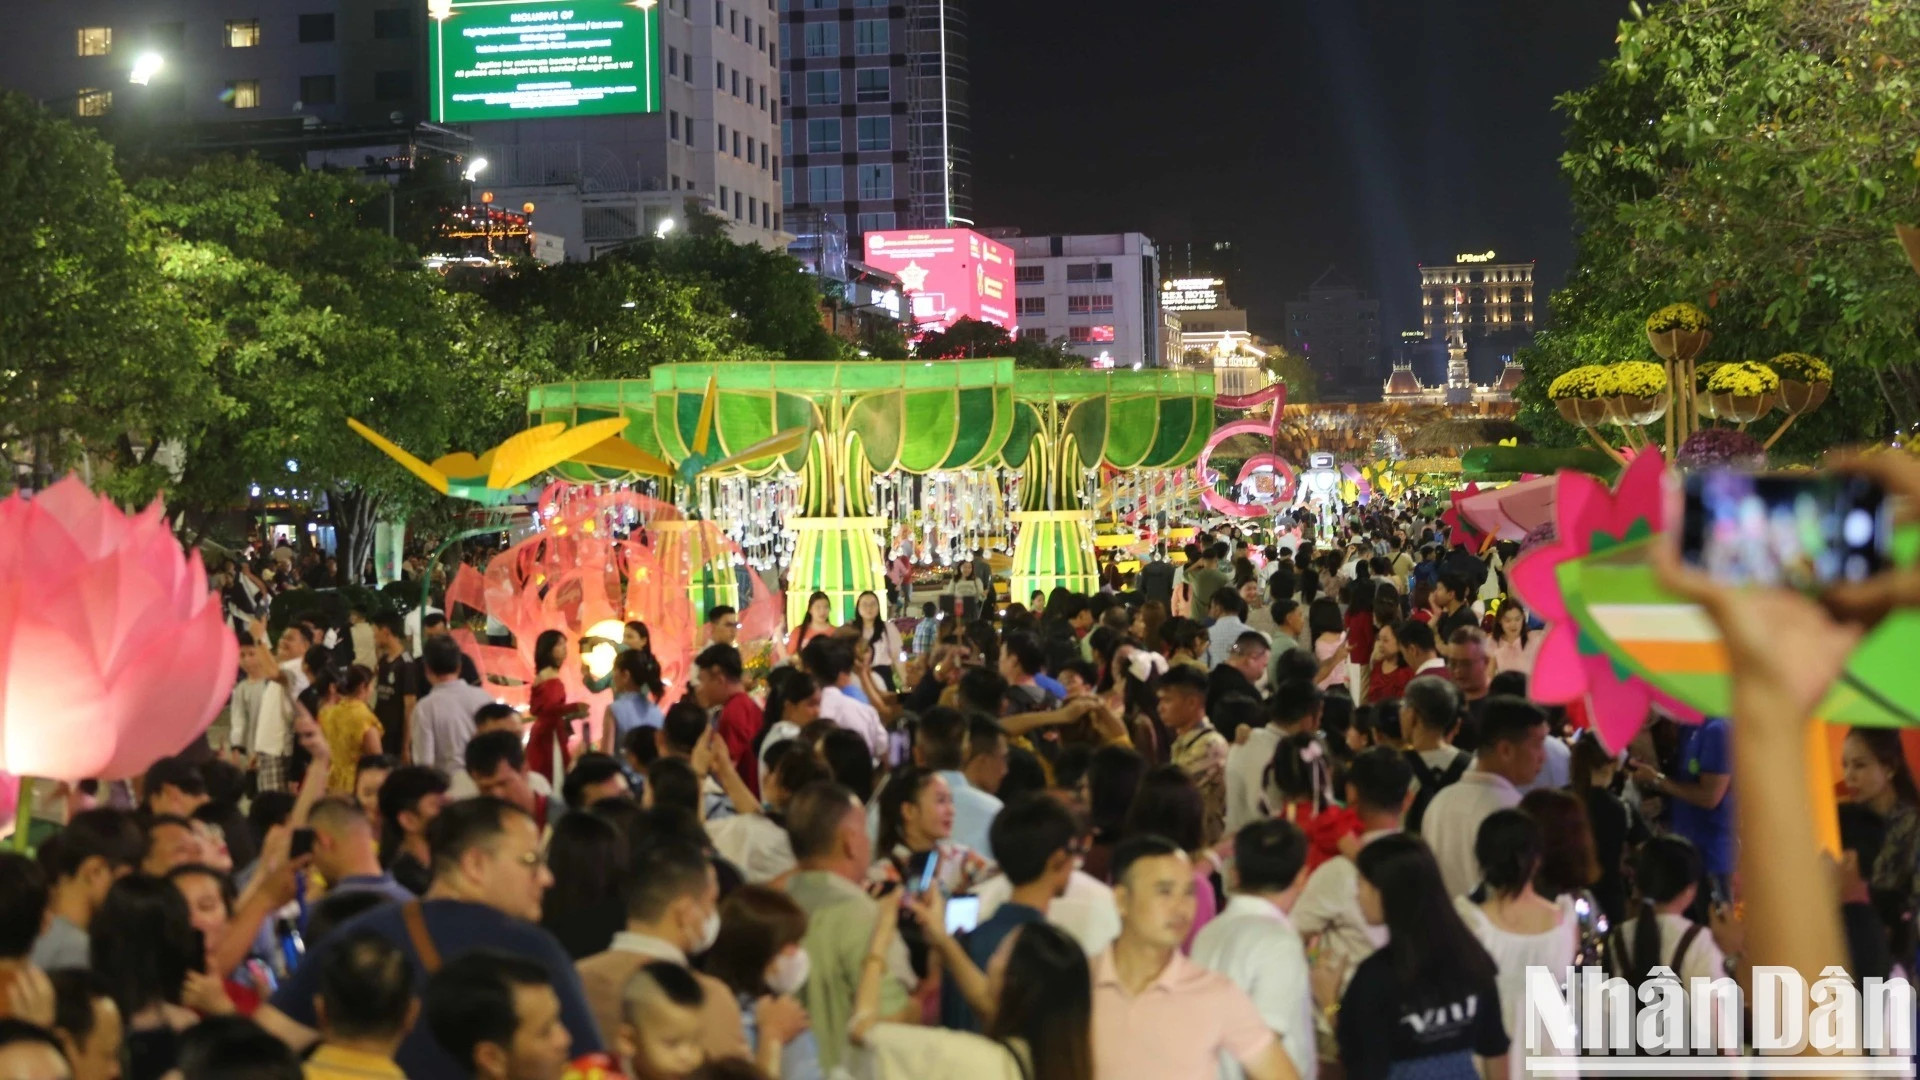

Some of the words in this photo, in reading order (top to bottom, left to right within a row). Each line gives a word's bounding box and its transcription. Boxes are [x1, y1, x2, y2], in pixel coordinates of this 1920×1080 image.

[511, 11, 558, 22] INCLUSIVE
[560, 10, 574, 20] OF
[1457, 253, 1487, 263] LPBank
[1185, 290, 1217, 299] HOTEL
